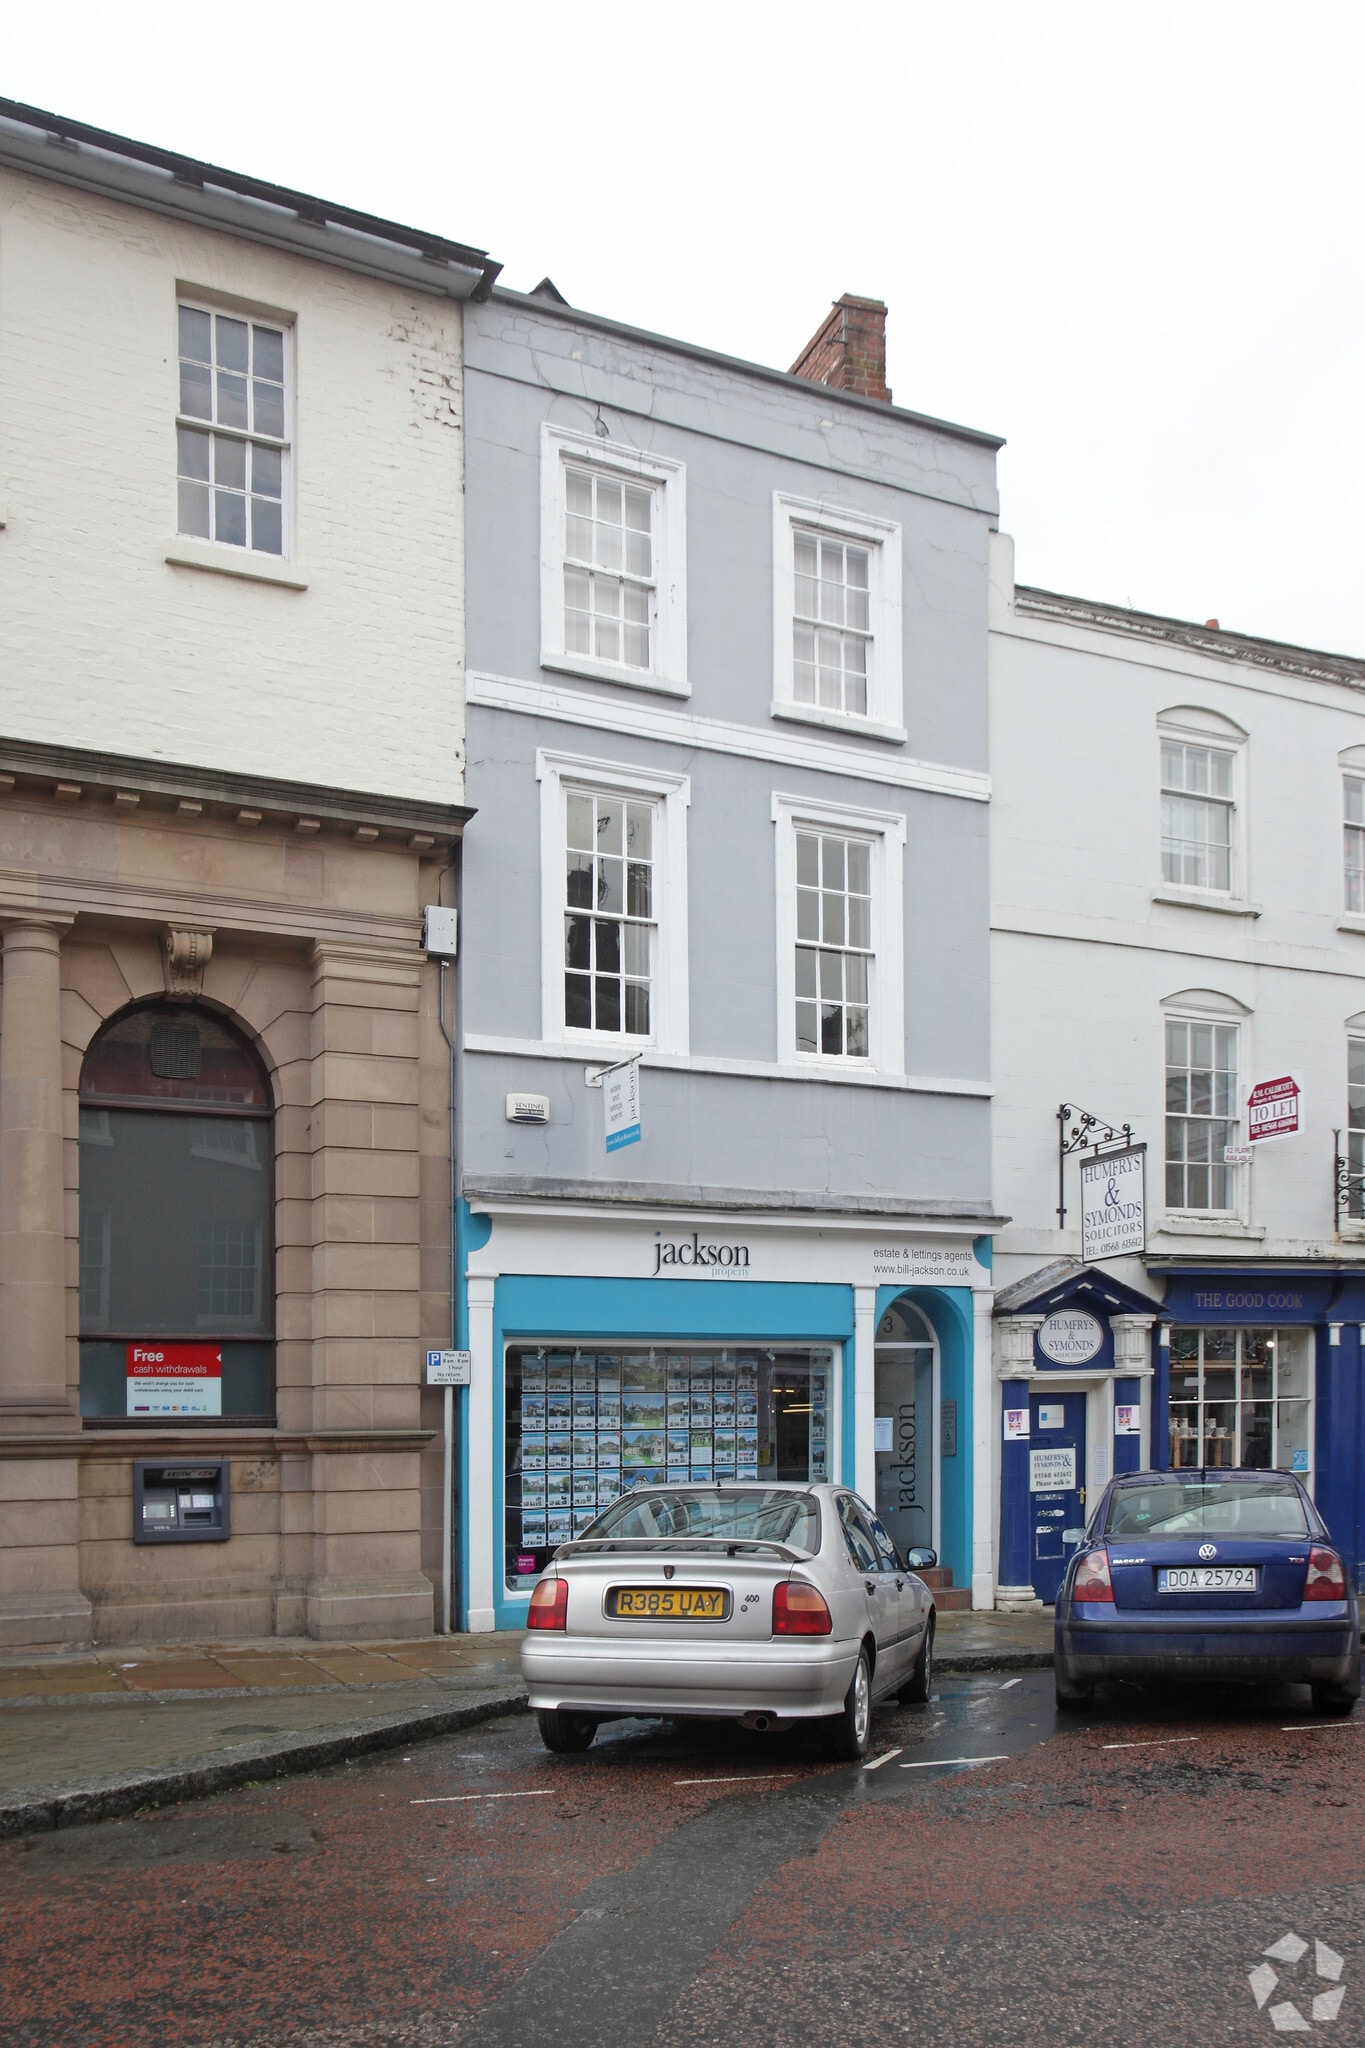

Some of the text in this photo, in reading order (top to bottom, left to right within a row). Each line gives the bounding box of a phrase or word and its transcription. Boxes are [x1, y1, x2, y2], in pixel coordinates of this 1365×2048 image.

[609, 1084, 621, 1094] estate
[628, 1070, 638, 1121] jackson
[612, 1094, 620, 1102] and
[609, 1102, 623, 1113] lettings
[1253, 1100, 1294, 1122] TO LET
[610, 1112, 623, 1123] agents
[1084, 1154, 1141, 1183] HUMFRYS
[1104, 1177, 1120, 1207] &
[1084, 1200, 1142, 1229] SYMONDS
[1084, 1220, 1142, 1243] SOLICITORS
[652, 1231, 751, 1276] jackson
[873, 1248, 973, 1263] estate & lettings agents
[1085, 1246, 1099, 1257] TEL:
[1100, 1242, 1120, 1254] 01568
[711, 1267, 750, 1278] property
[873, 1264, 970, 1277] www.bill-jackson.co.uk
[1195, 1292, 1304, 1308] THE GOOD COOK
[883, 1315, 894, 1334] 3
[1049, 1319, 1094, 1330] HUMFRYS
[1067, 1330, 1075, 1340] &
[1048, 1340, 1095, 1351] SYMONDS
[133, 1348, 164, 1362] Free
[133, 1364, 207, 1374] cash withdrawals
[888, 1401, 926, 1514] jackson
[1033, 1453, 1072, 1467] HUMFRYS &
[1033, 1461, 1062, 1469] SYMONDS
[1168, 1570, 1199, 1587] DOA
[1204, 1569, 1254, 1586] 25794
[620, 1592, 721, 1613] R385 UAY
[744, 1594, 760, 1603] 400
